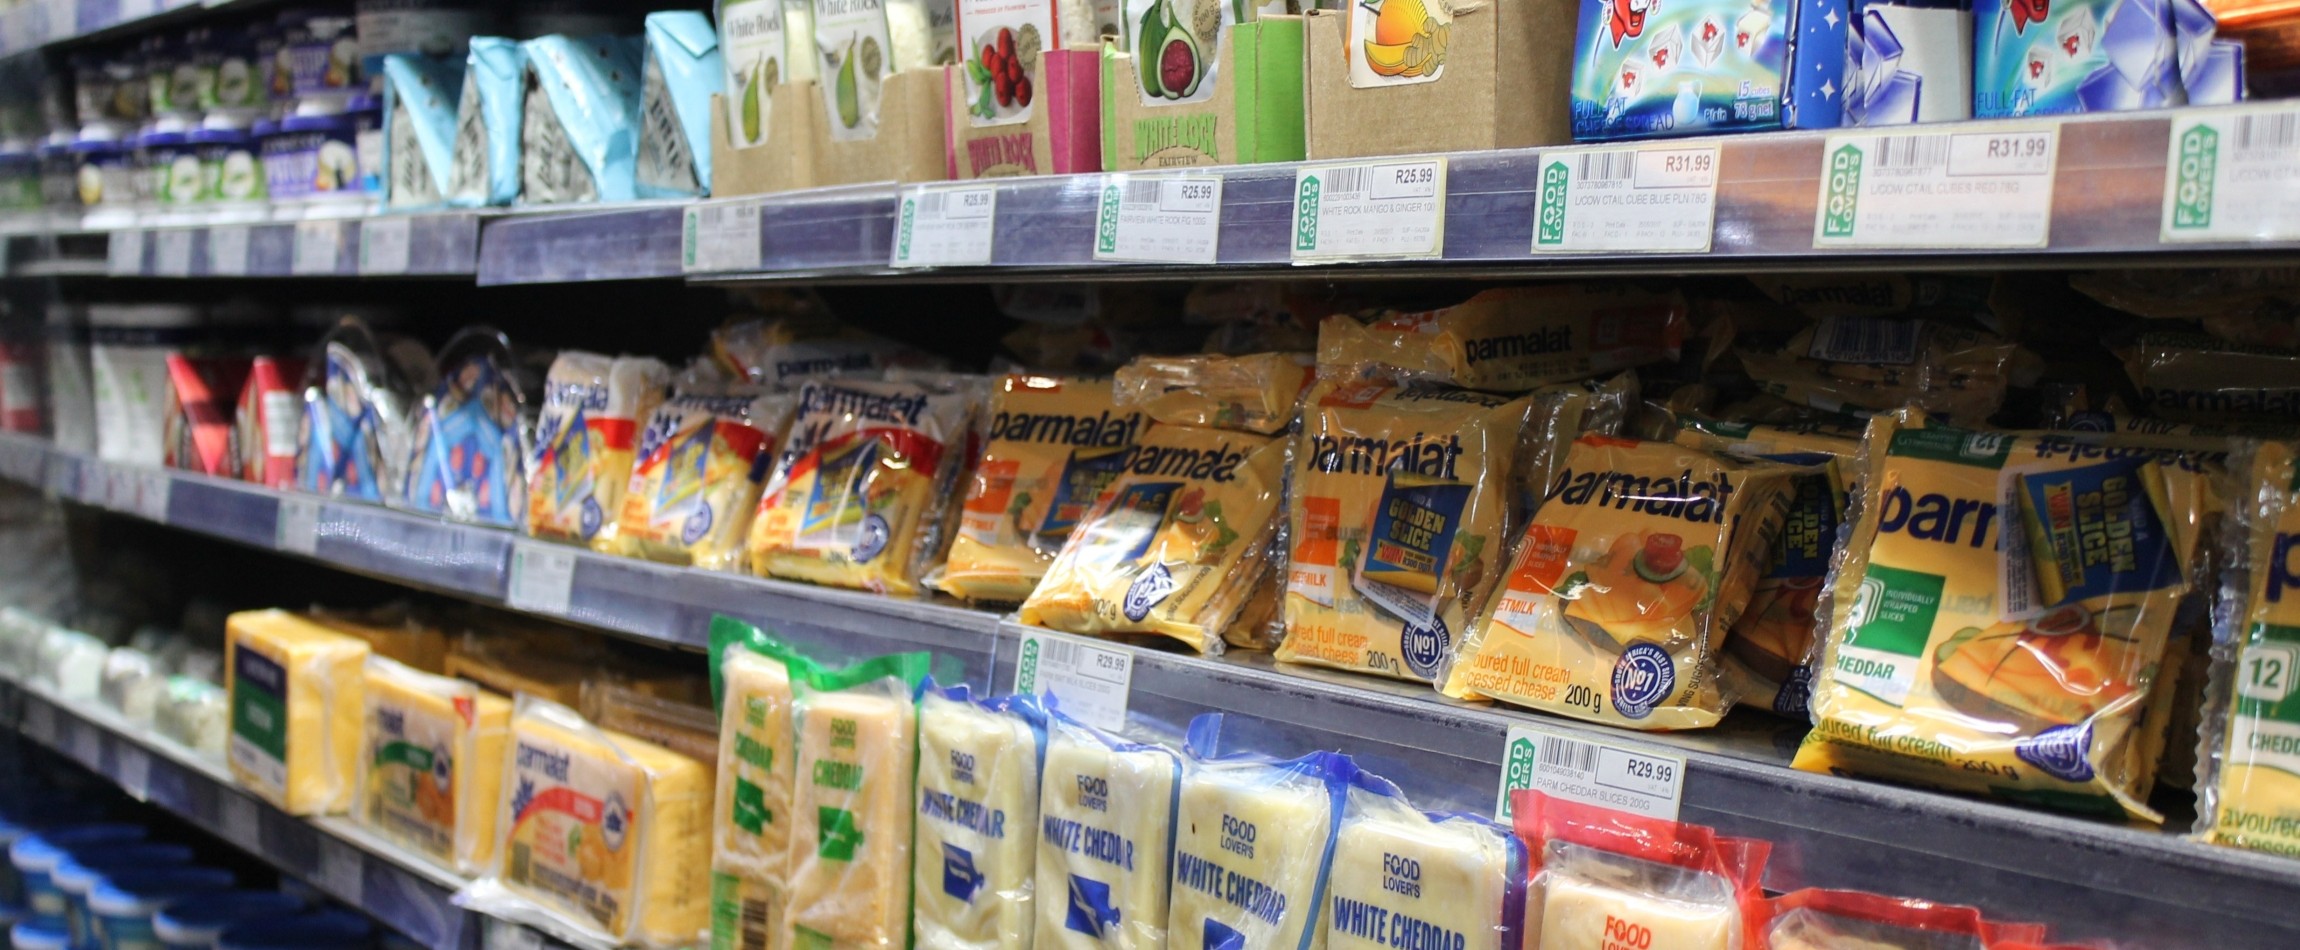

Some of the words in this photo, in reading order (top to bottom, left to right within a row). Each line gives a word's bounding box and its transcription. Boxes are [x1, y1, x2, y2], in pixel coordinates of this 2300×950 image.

[756, 10, 780, 34] Rock
[1738, 81, 1750, 97] 15
[1703, 108, 1728, 122] Plain
[1734, 104, 1747, 119] 78
[1749, 105, 1757, 121] g
[1757, 101, 1774, 117] net
[1133, 118, 1178, 165] WHITE
[1987, 139, 2045, 159] R31.99
[1394, 168, 1433, 185] R25.99
[1665, 154, 1711, 173] R31.99
[2177, 130, 2201, 225] FOOD
[963, 194, 989, 207] R25.99
[1181, 185, 1212, 200] R25.99
[1541, 168, 1557, 241] FOOD
[1552, 169, 1566, 240] LOVER'S
[1626, 194, 1648, 205] CUBE
[1649, 193, 1671, 204] BLUE
[1827, 152, 1849, 233] FOOD
[1841, 153, 1860, 233] LOVER'S
[1100, 189, 1113, 250] FOOD
[1300, 182, 1311, 247] FOOD
[1308, 183, 1318, 247] LOVER'S
[1322, 206, 1343, 216] WHITE
[1344, 205, 1362, 215] ROCK
[1363, 204, 1389, 214] MANGO
[1395, 203, 1422, 213] GINGER
[1465, 325, 1573, 366] parmalat
[990, 410, 1141, 447] parmalat
[1389, 498, 1447, 536] GOLDEN
[2049, 491, 2070, 530] WIN
[2102, 476, 2136, 573] GOLDEN
[1389, 519, 1434, 551] SLICE
[2076, 491, 2109, 567] SLICE
[1381, 543, 1404, 564] WIN
[1883, 600, 1919, 614] WRAPPED
[1885, 589, 1935, 605] INDIVIDUALLY
[1880, 611, 1906, 622] SLICES
[1317, 625, 1335, 644] full
[1096, 653, 1126, 672] R29.99
[1366, 649, 1389, 670] 200
[1510, 654, 1531, 676] full
[1533, 663, 1571, 685] cream
[2248, 658, 2283, 688] 12
[1465, 669, 1510, 692] cessed
[1512, 676, 1556, 701] cheese
[1564, 684, 1591, 709] 200
[1592, 692, 1602, 714] g
[951, 750, 975, 771] FOOD
[1897, 734, 1952, 760] cream
[1076, 773, 1108, 798] FOOD
[1627, 758, 1672, 783] R29.99
[920, 787, 954, 825] WHITE
[1077, 796, 1107, 813] LOVER'S
[1537, 776, 1559, 792] PARM
[1560, 782, 1597, 799] CHEDDAR
[1600, 790, 1628, 807] SLICES
[1629, 797, 1651, 811] 200G
[1043, 813, 1082, 853] WHITE
[1221, 813, 1257, 844] FOOD
[1220, 837, 1255, 860] LOVER'S
[1383, 851, 1422, 881] FOOD
[1176, 851, 1224, 900] WHITE
[1226, 871, 1286, 927] CHEDDAR
[1383, 874, 1421, 900] LOVER'S
[1333, 895, 1388, 945] WHITE
[1389, 912, 1466, 950] CHEDDAR
[1604, 914, 1652, 950] FOOD
